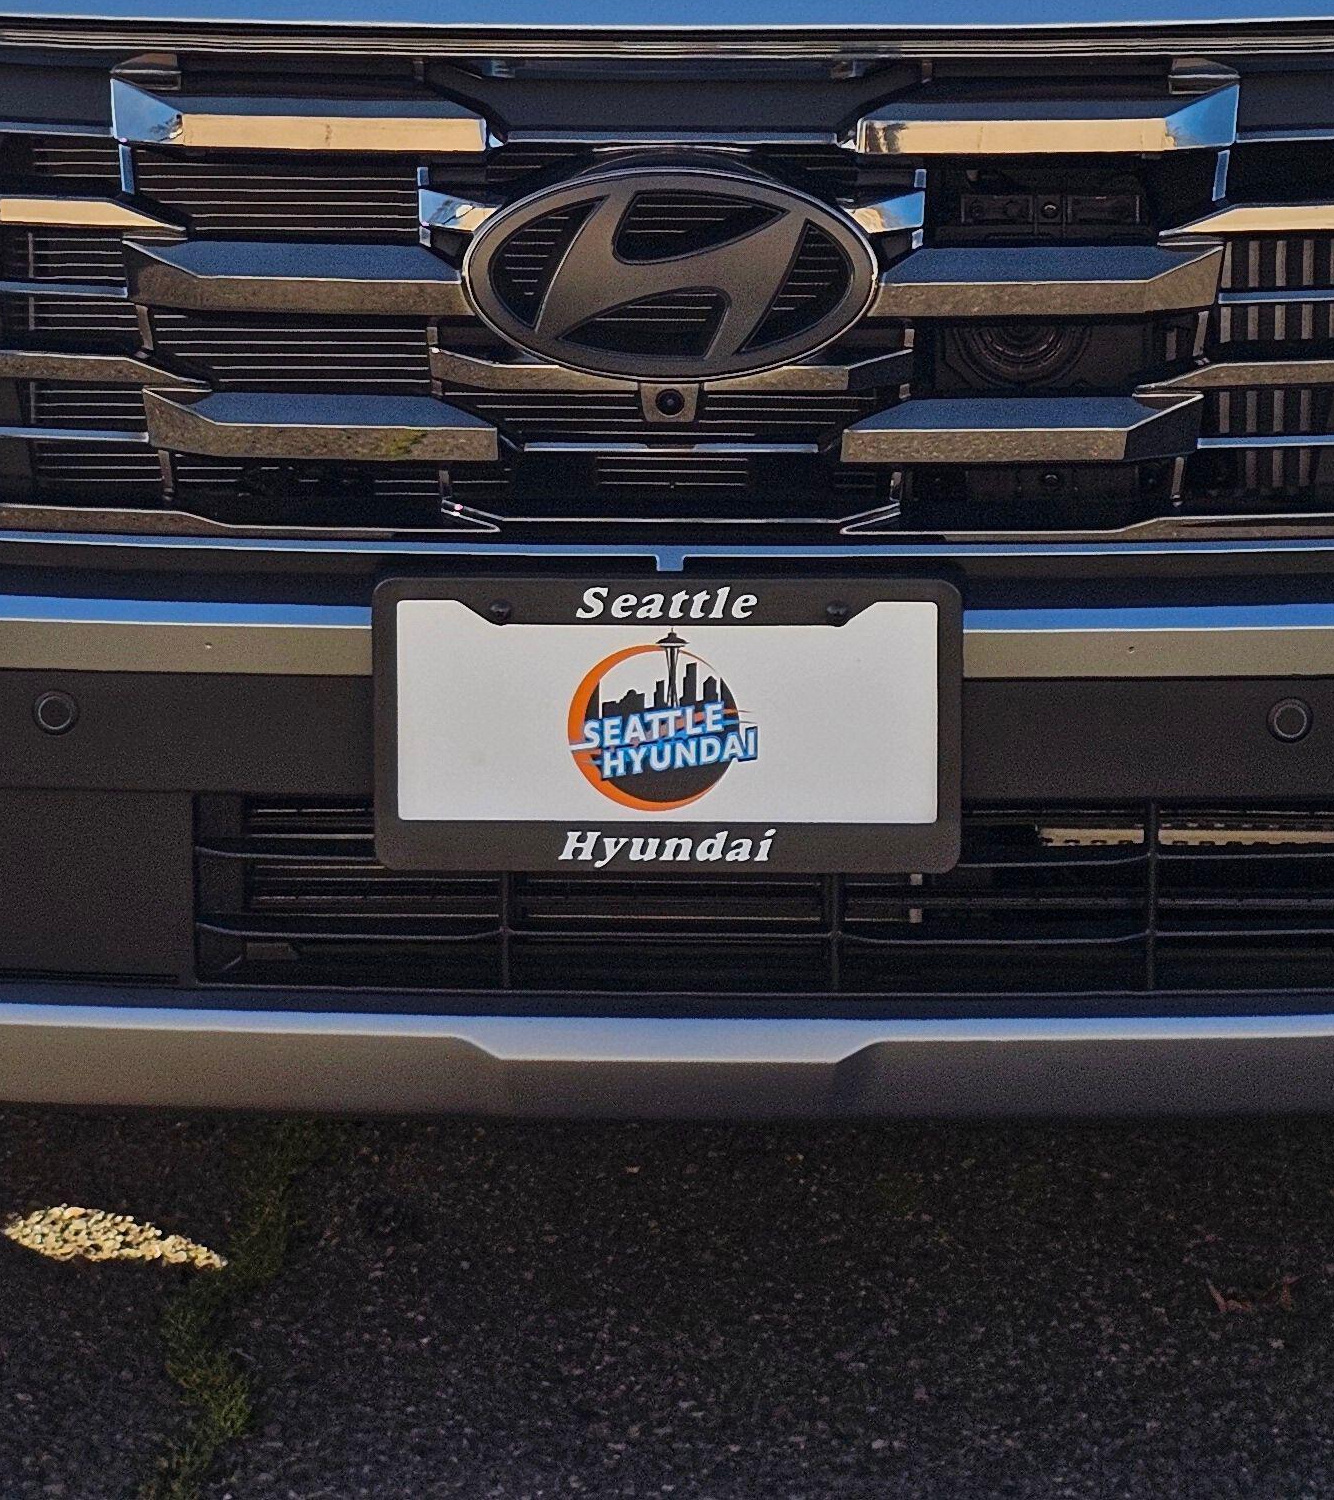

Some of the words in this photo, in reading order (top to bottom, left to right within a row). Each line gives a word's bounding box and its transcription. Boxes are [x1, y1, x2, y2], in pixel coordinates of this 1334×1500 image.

[576, 586, 758, 618] Seattle
[583, 702, 724, 748] SEATTLE
[602, 729, 757, 779] HYUNDAI
[558, 828, 777, 868] Hyundai
